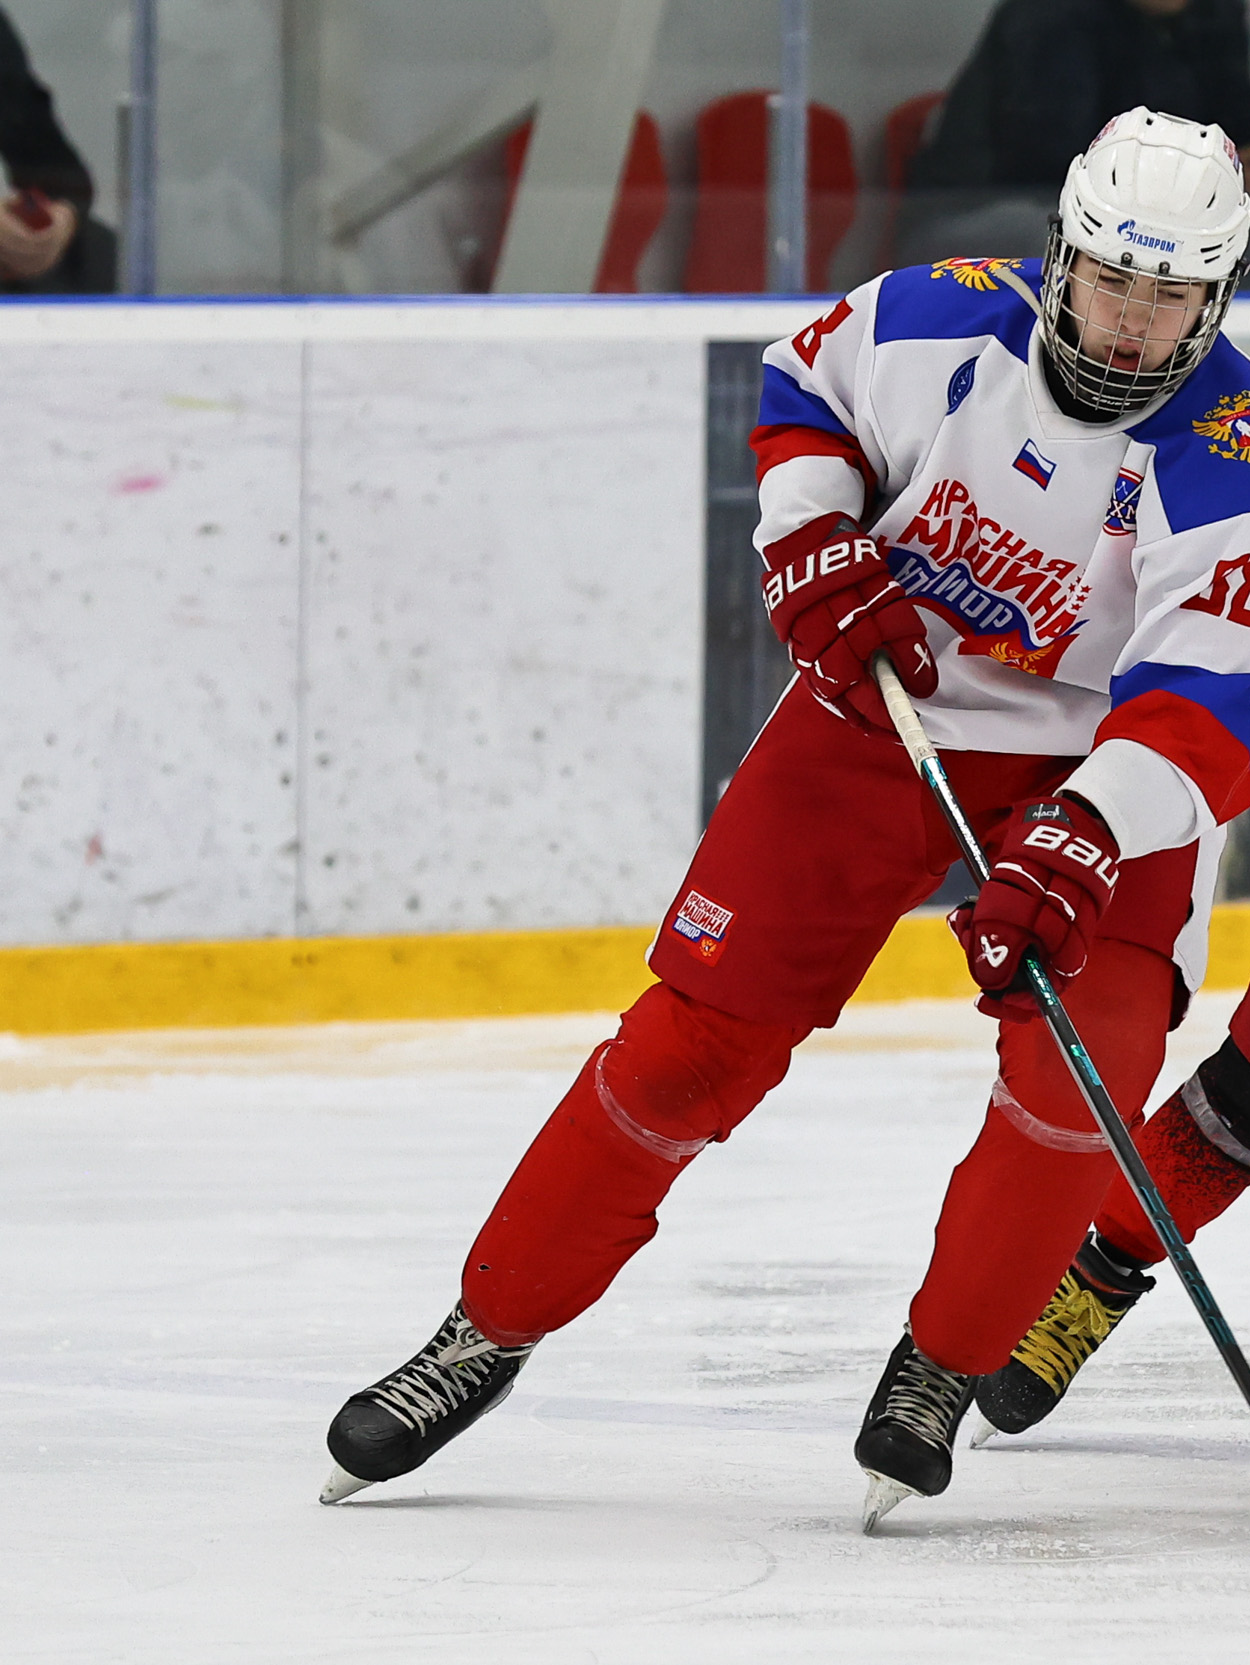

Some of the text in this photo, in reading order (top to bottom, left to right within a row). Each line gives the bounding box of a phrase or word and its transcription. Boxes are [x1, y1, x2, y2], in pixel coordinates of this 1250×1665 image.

[1131, 235, 1176, 253] ГАЗПРОМ
[919, 479, 1077, 582] КРАСНАЯ
[764, 538, 882, 612] AUER
[896, 515, 1078, 641] МАШИНА
[673, 917, 702, 940] ЮНИОР
[680, 902, 724, 936] МАШИНА
